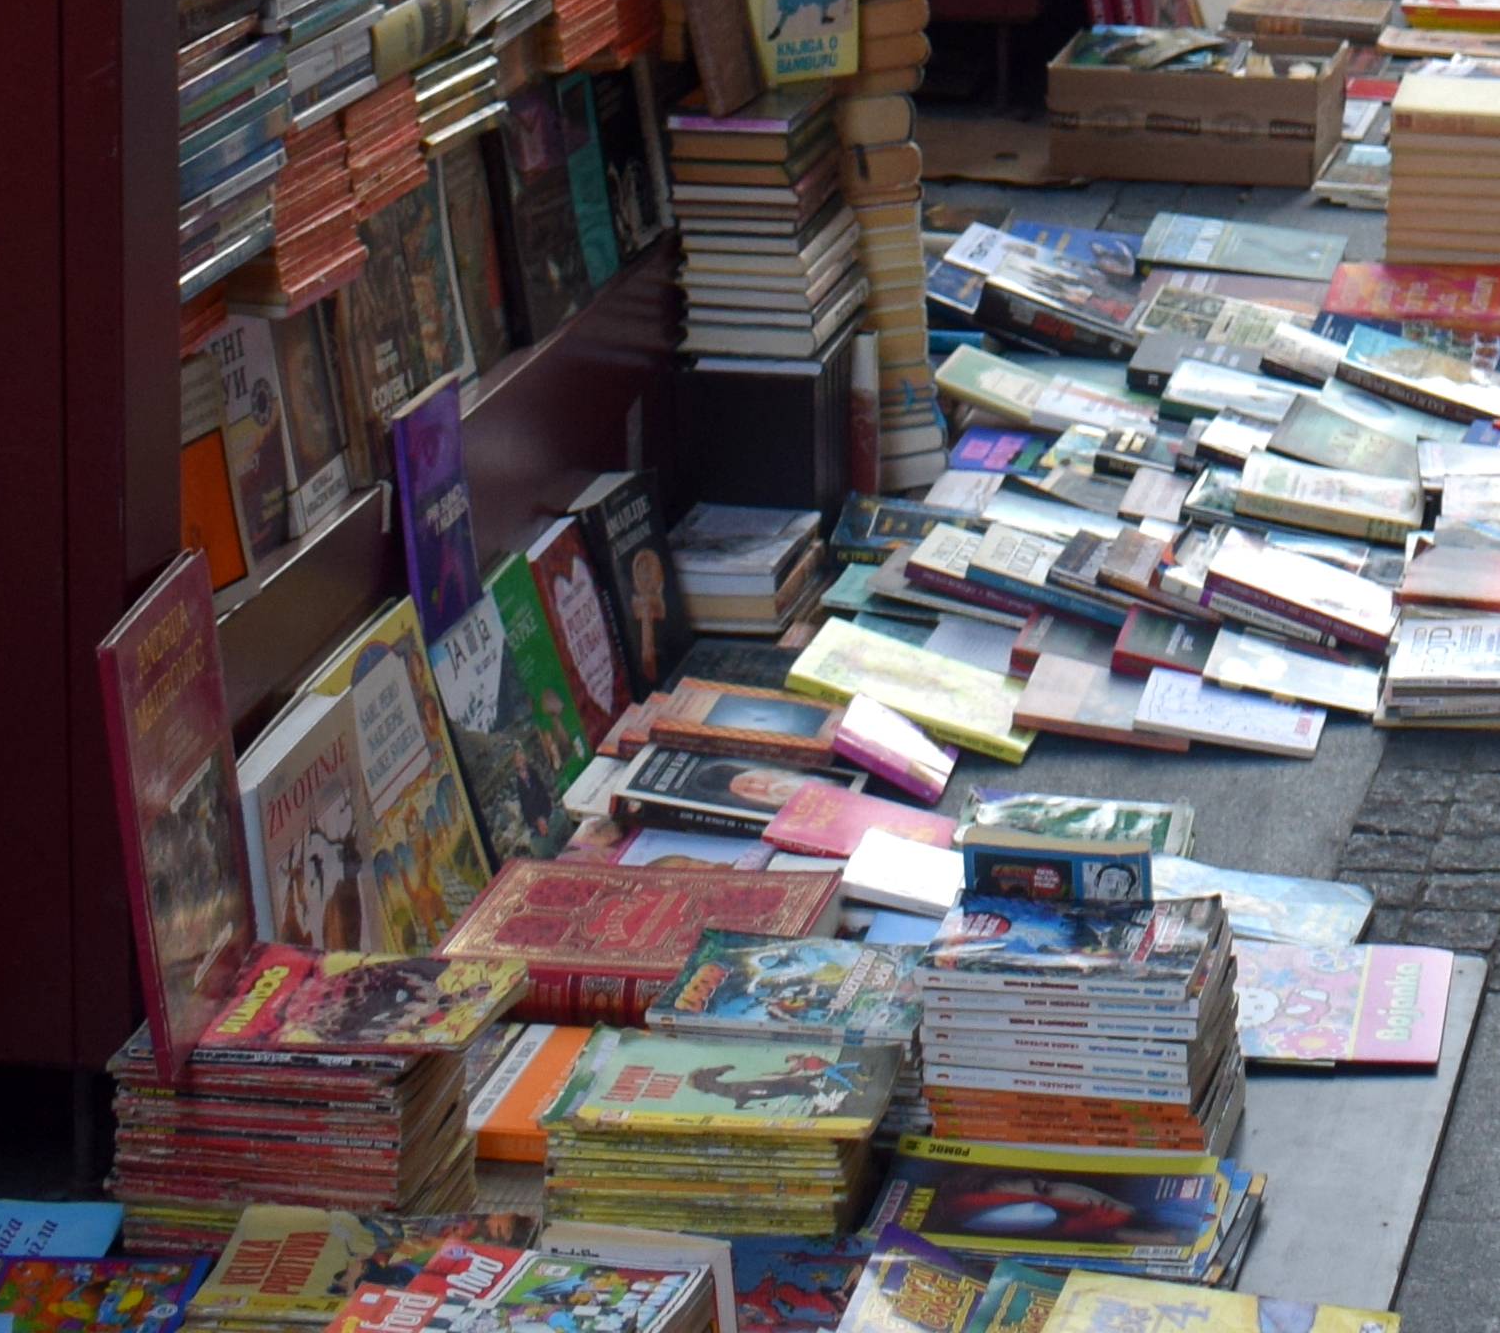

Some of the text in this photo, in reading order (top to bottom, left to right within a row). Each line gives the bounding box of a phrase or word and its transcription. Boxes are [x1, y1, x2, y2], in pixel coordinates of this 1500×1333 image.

[776, 36, 839, 56] KNJIGA O
[137, 599, 190, 681] ANDRIJA
[267, 731, 347, 839] ŽIVOTINJE
[1375, 961, 1425, 1042] Bojanka
[218, 1239, 283, 1286] VELIKA
